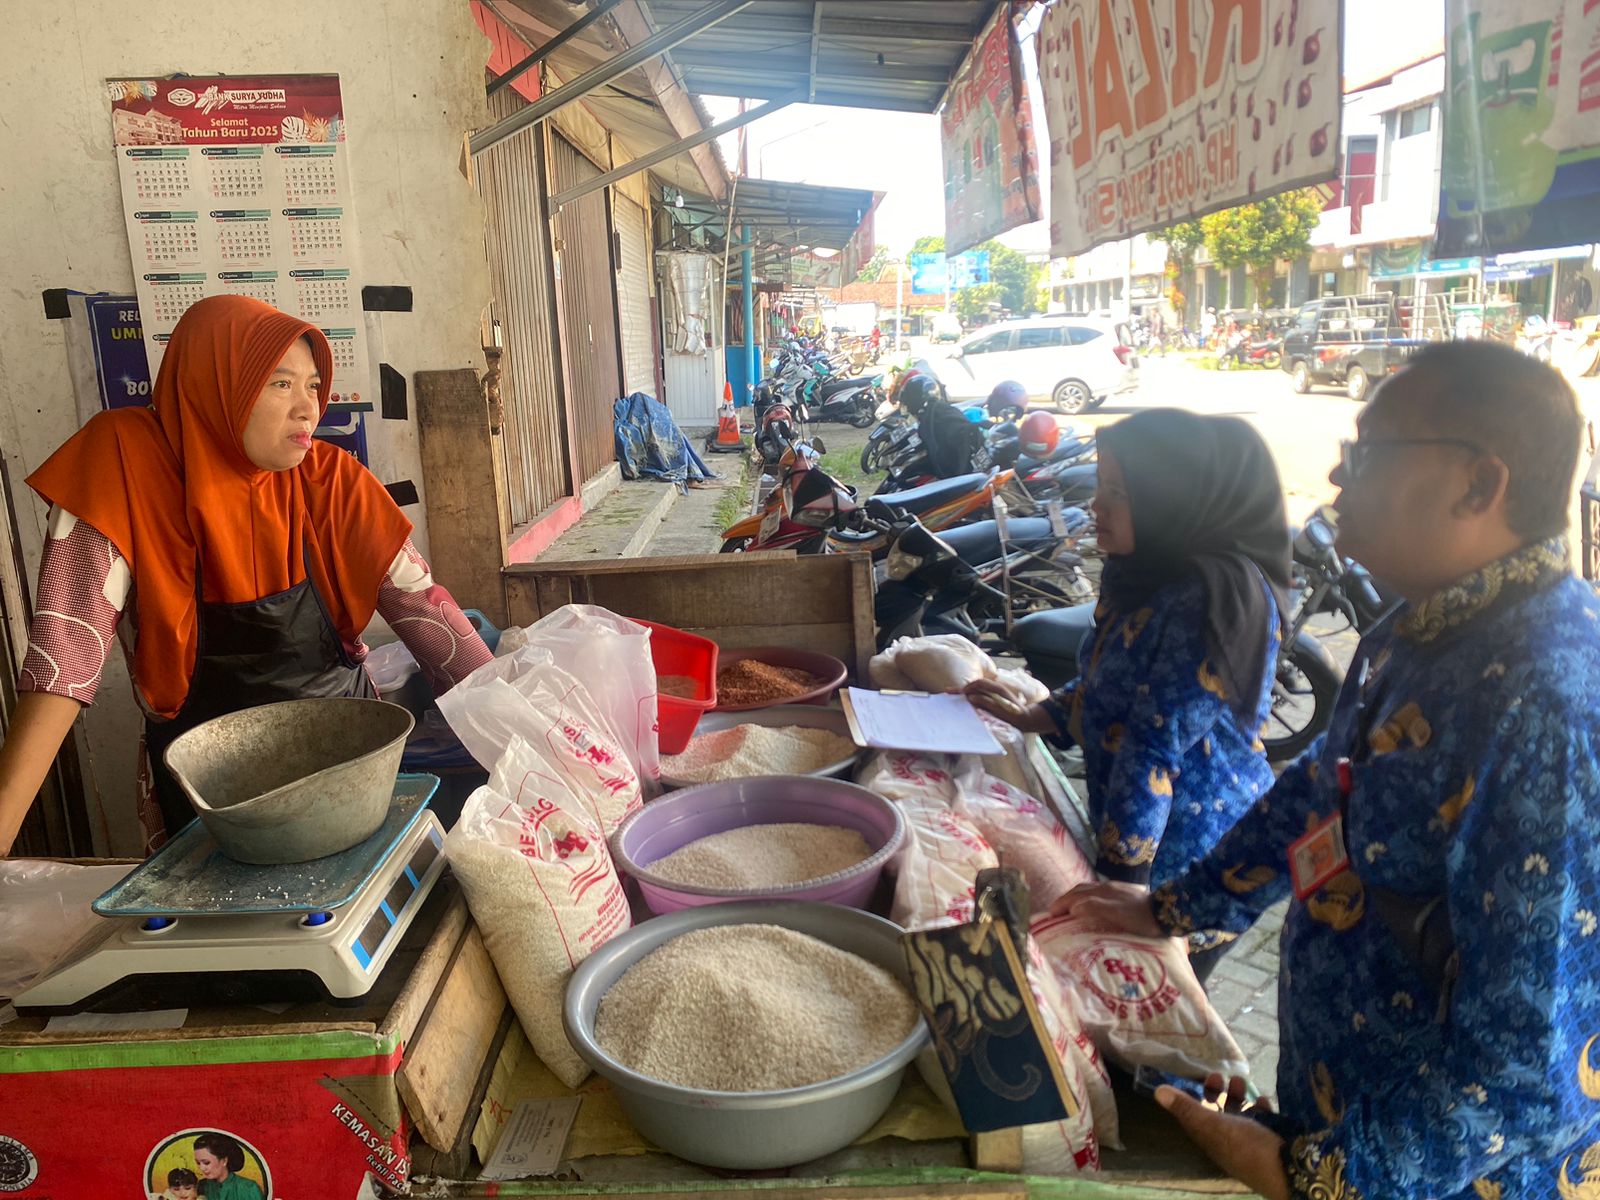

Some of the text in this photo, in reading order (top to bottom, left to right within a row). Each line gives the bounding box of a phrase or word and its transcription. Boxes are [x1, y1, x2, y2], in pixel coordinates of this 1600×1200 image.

[231, 91, 256, 101] SURYA
[257, 91, 284, 100] YUDHA
[211, 118, 249, 126] Selamat
[182, 126, 278, 138] Tahun Baru 2025
[331, 1102, 398, 1166] KEMASAN
[365, 1153, 389, 1177] Refill
